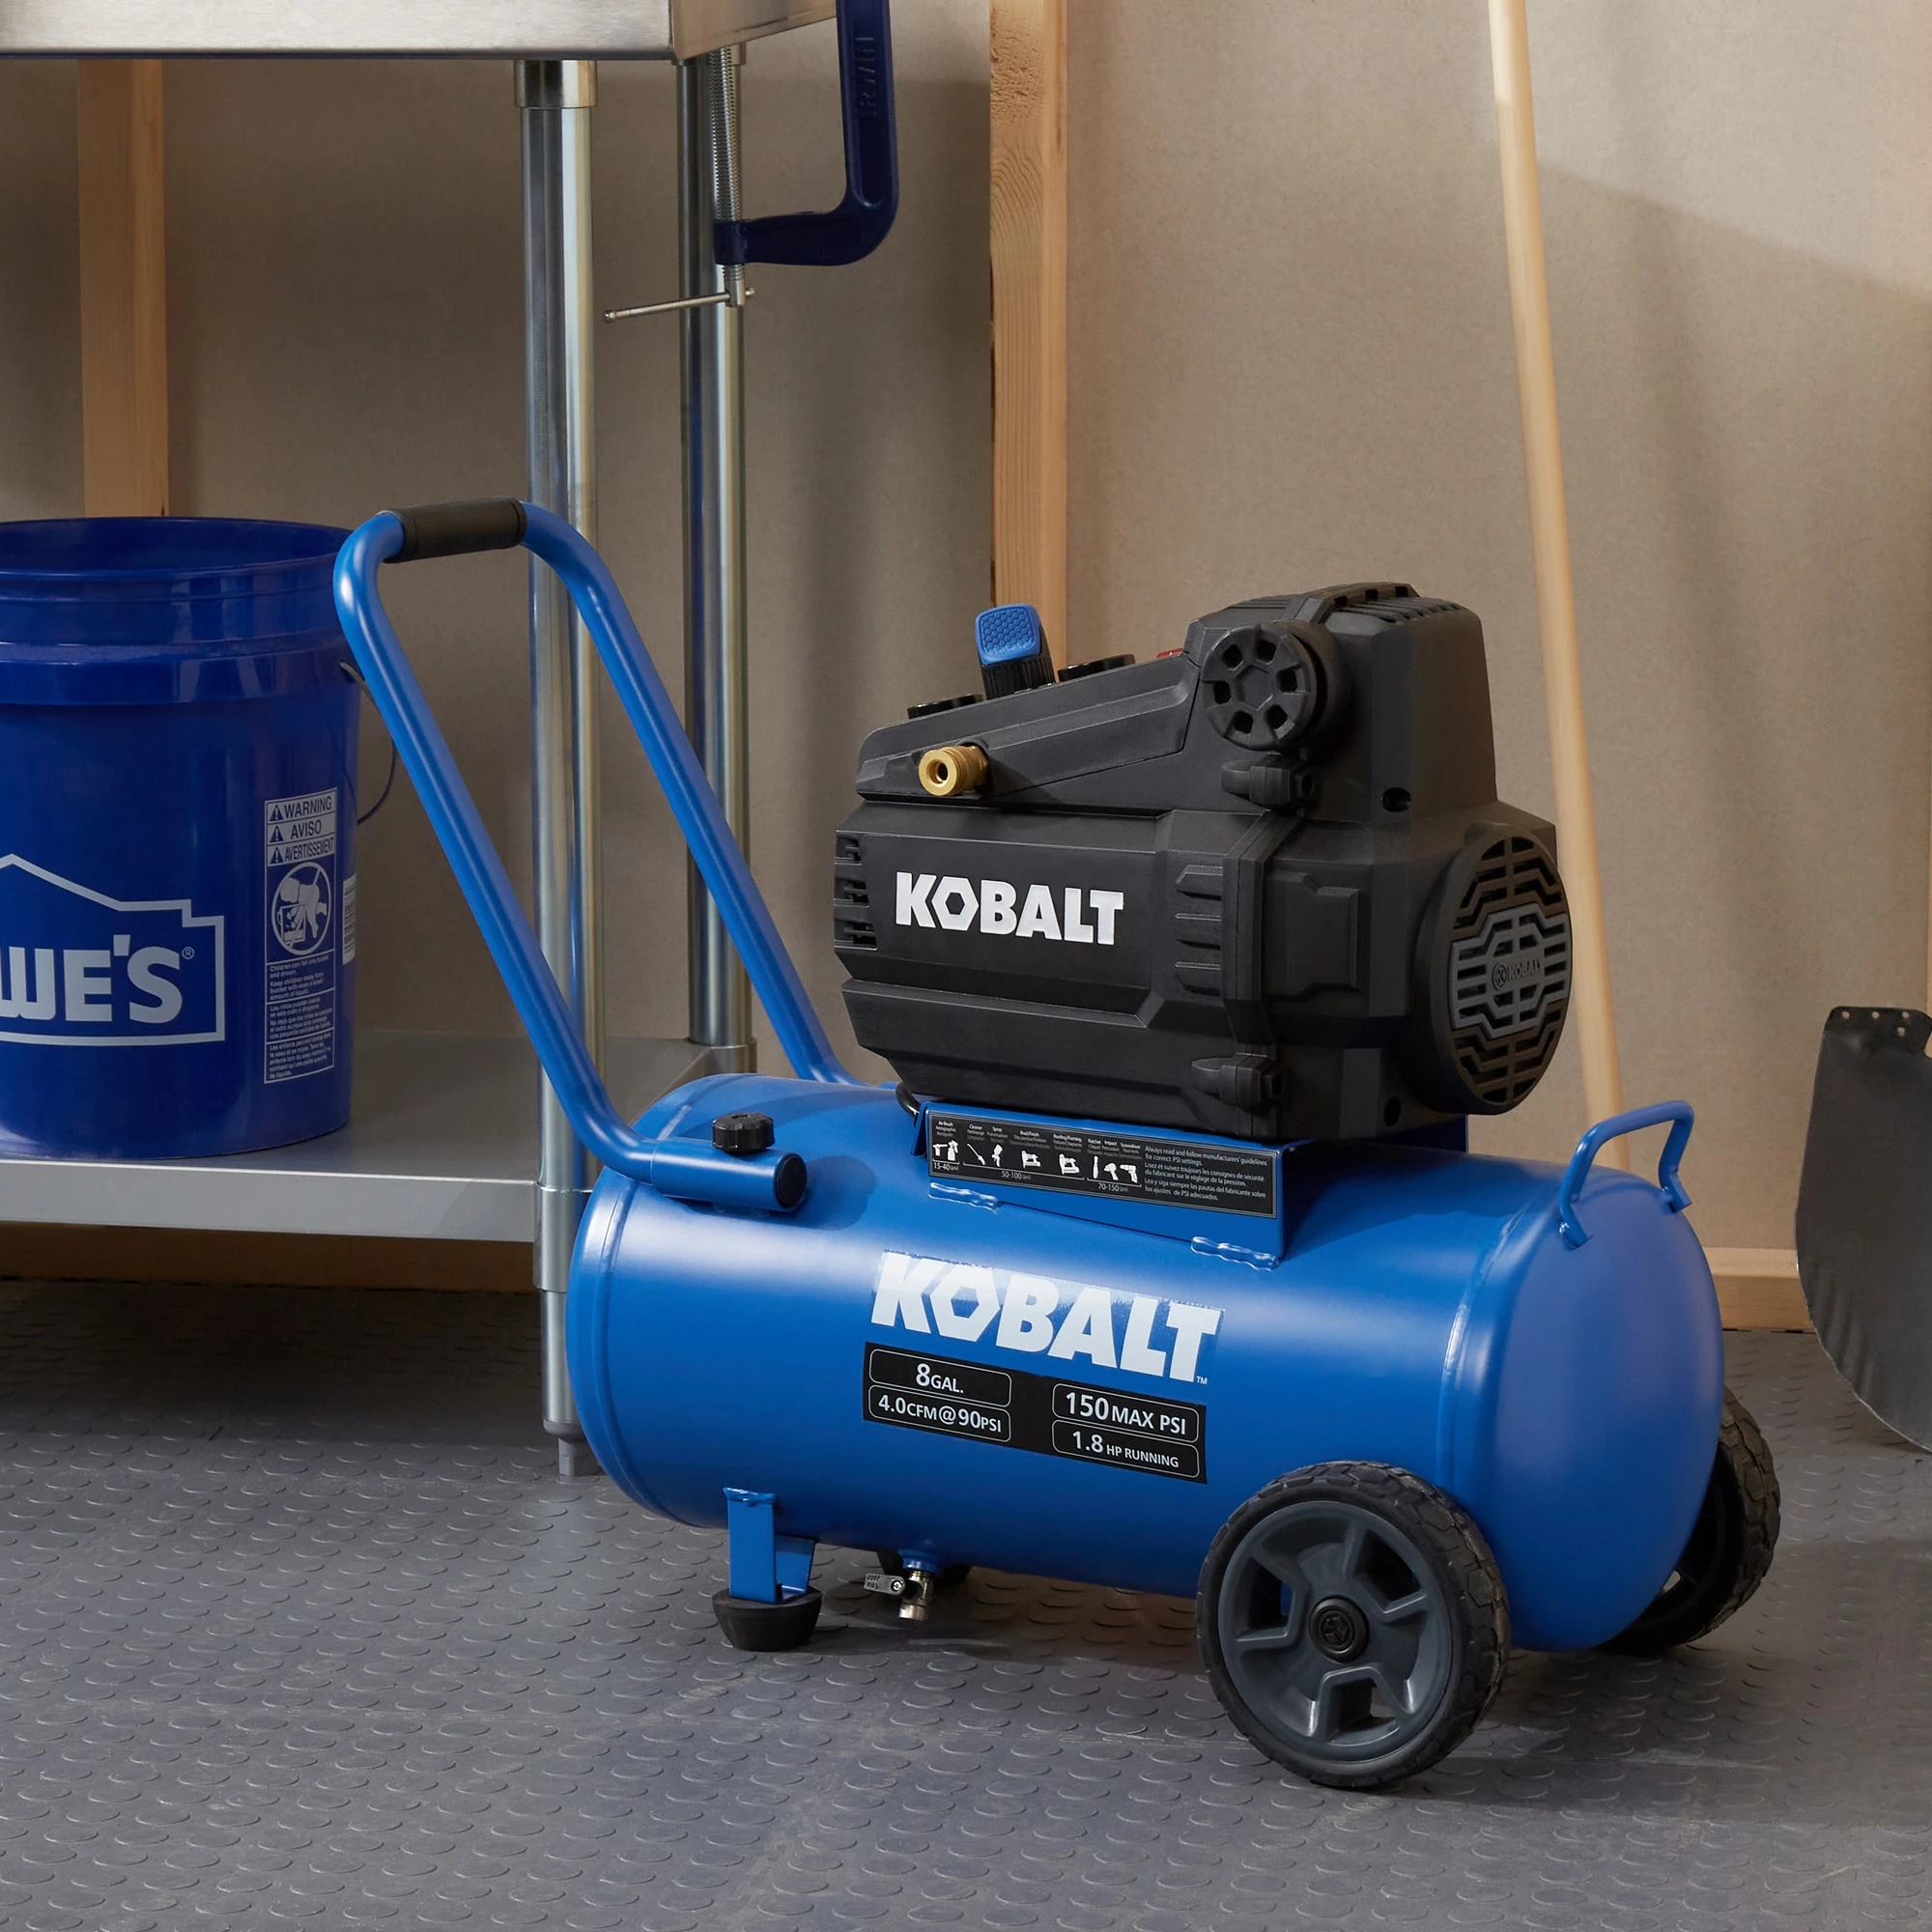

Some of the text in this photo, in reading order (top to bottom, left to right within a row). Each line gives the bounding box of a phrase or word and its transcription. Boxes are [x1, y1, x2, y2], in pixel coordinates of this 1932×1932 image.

[284, 796, 331, 818] WARNING
[291, 819, 321, 838] AVISO
[285, 838, 333, 862] AVERTISSEMENT
[895, 871, 1124, 945] KOBALT
[933, 1162, 950, 1171] 15-40
[1145, 1146, 1162, 1154] Always
[1240, 1157, 1267, 1166] guidelines
[870, 1252, 1222, 1382] KOBALT
[1160, 1414, 1185, 1435] PSI
[1072, 1431, 1179, 1467] 1.8 HP RUNNING
